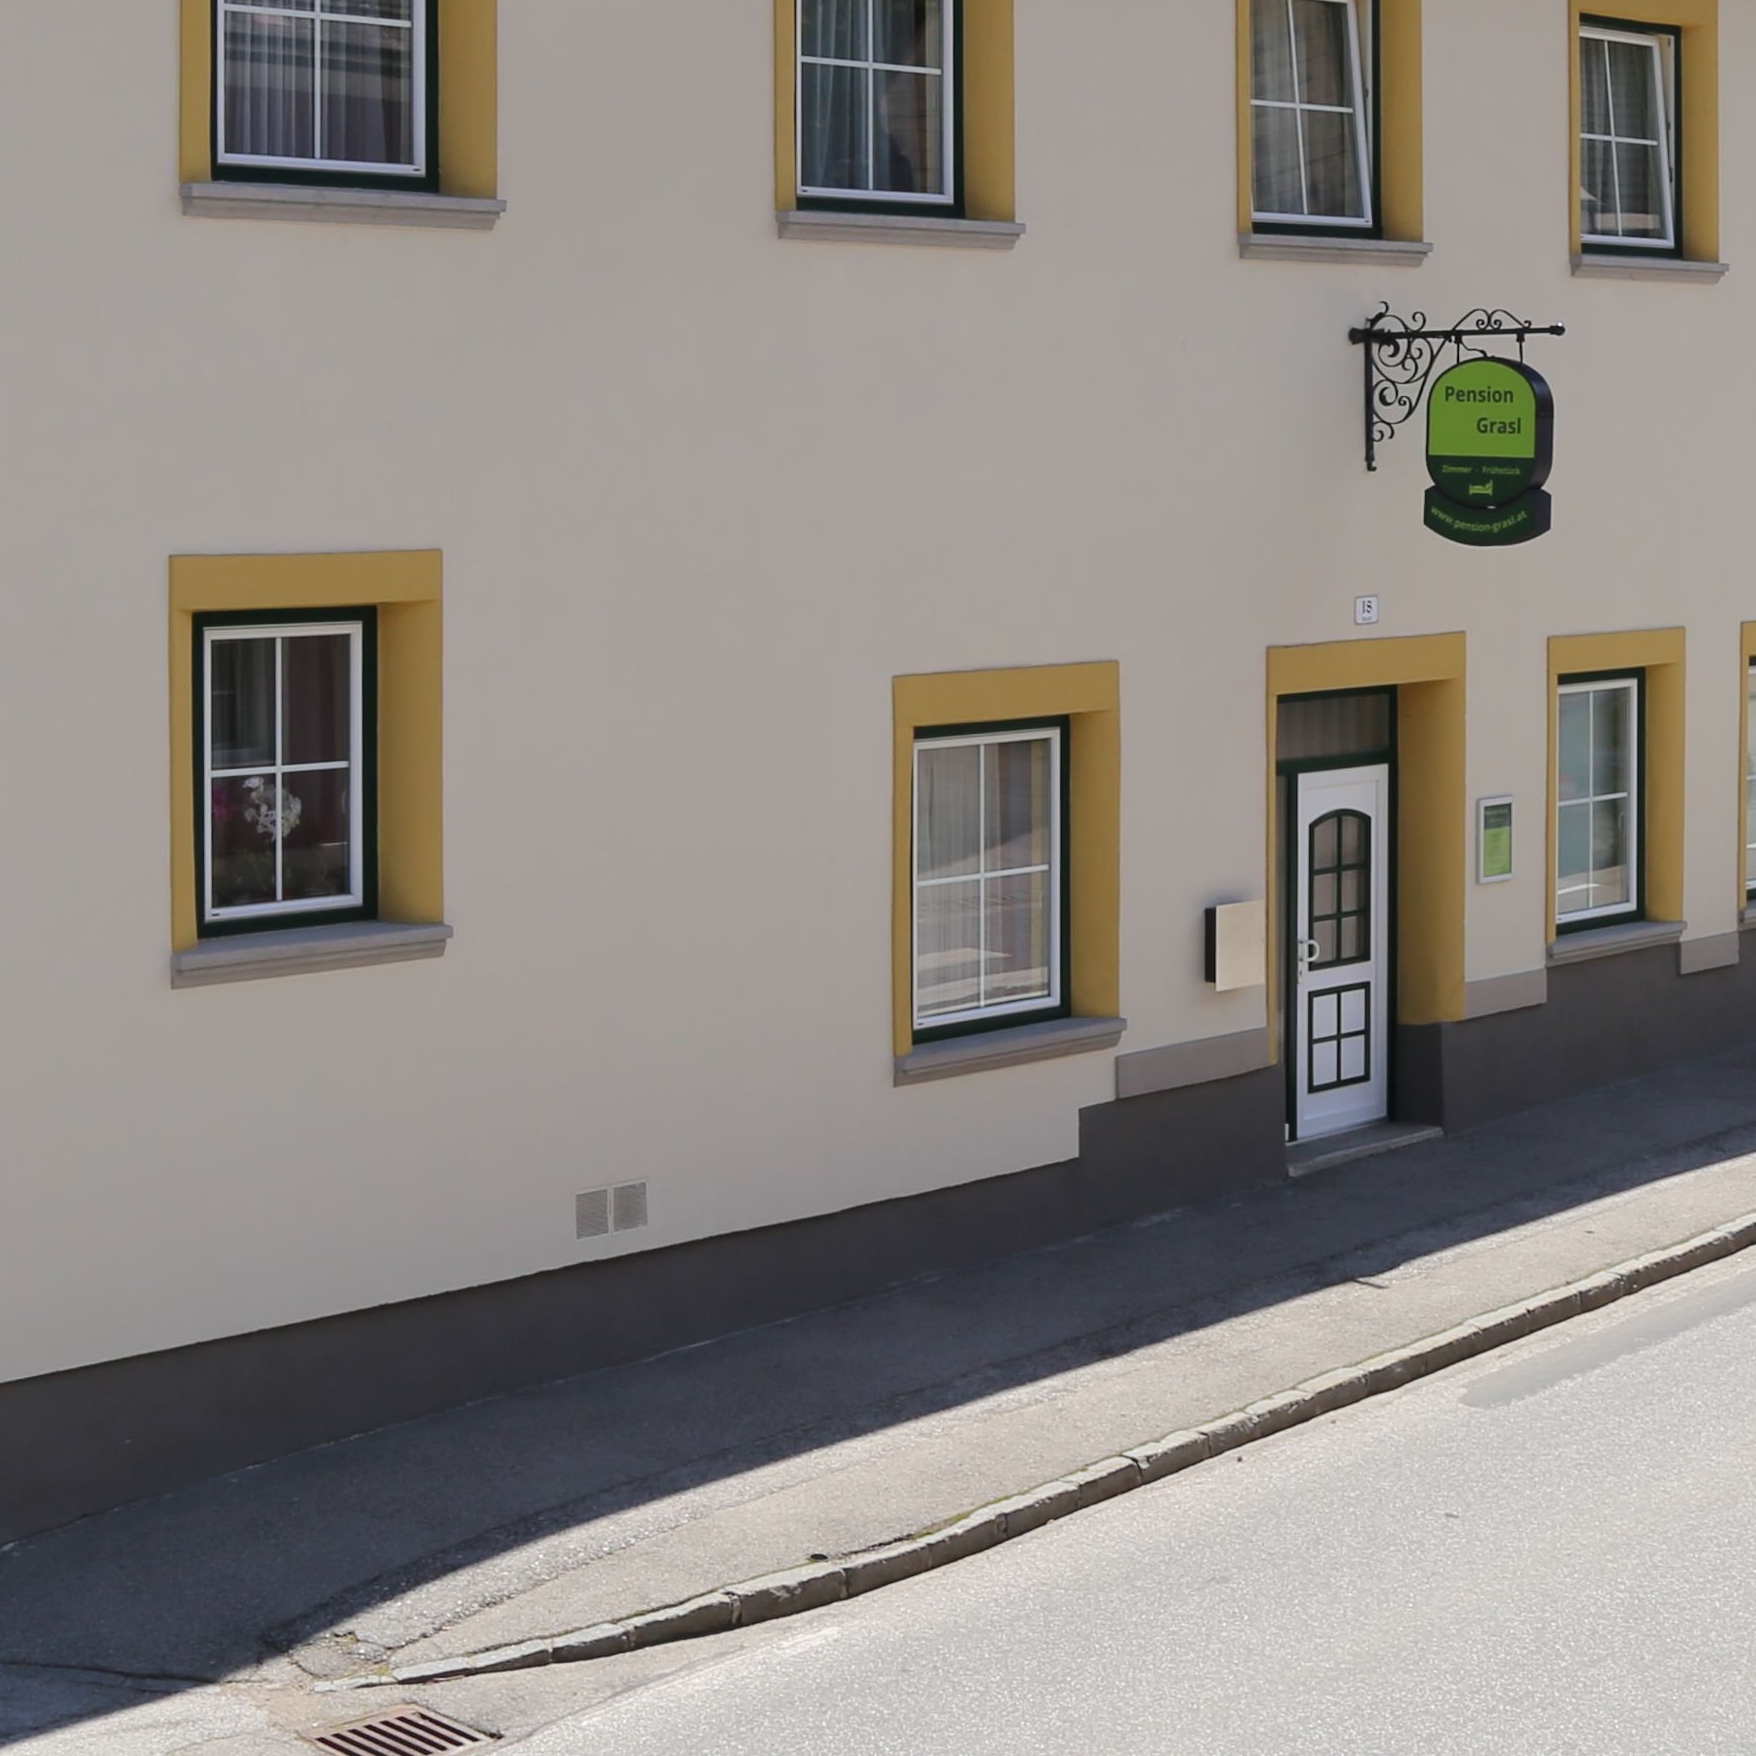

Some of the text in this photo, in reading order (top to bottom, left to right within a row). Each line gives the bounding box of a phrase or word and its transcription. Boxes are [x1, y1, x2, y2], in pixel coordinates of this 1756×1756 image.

[1444, 386, 1514, 403] Pension
[1476, 417, 1522, 434] Grasl
[1430, 506, 1527, 533] www.pension-grasl.at
[1362, 600, 1373, 614] 18
